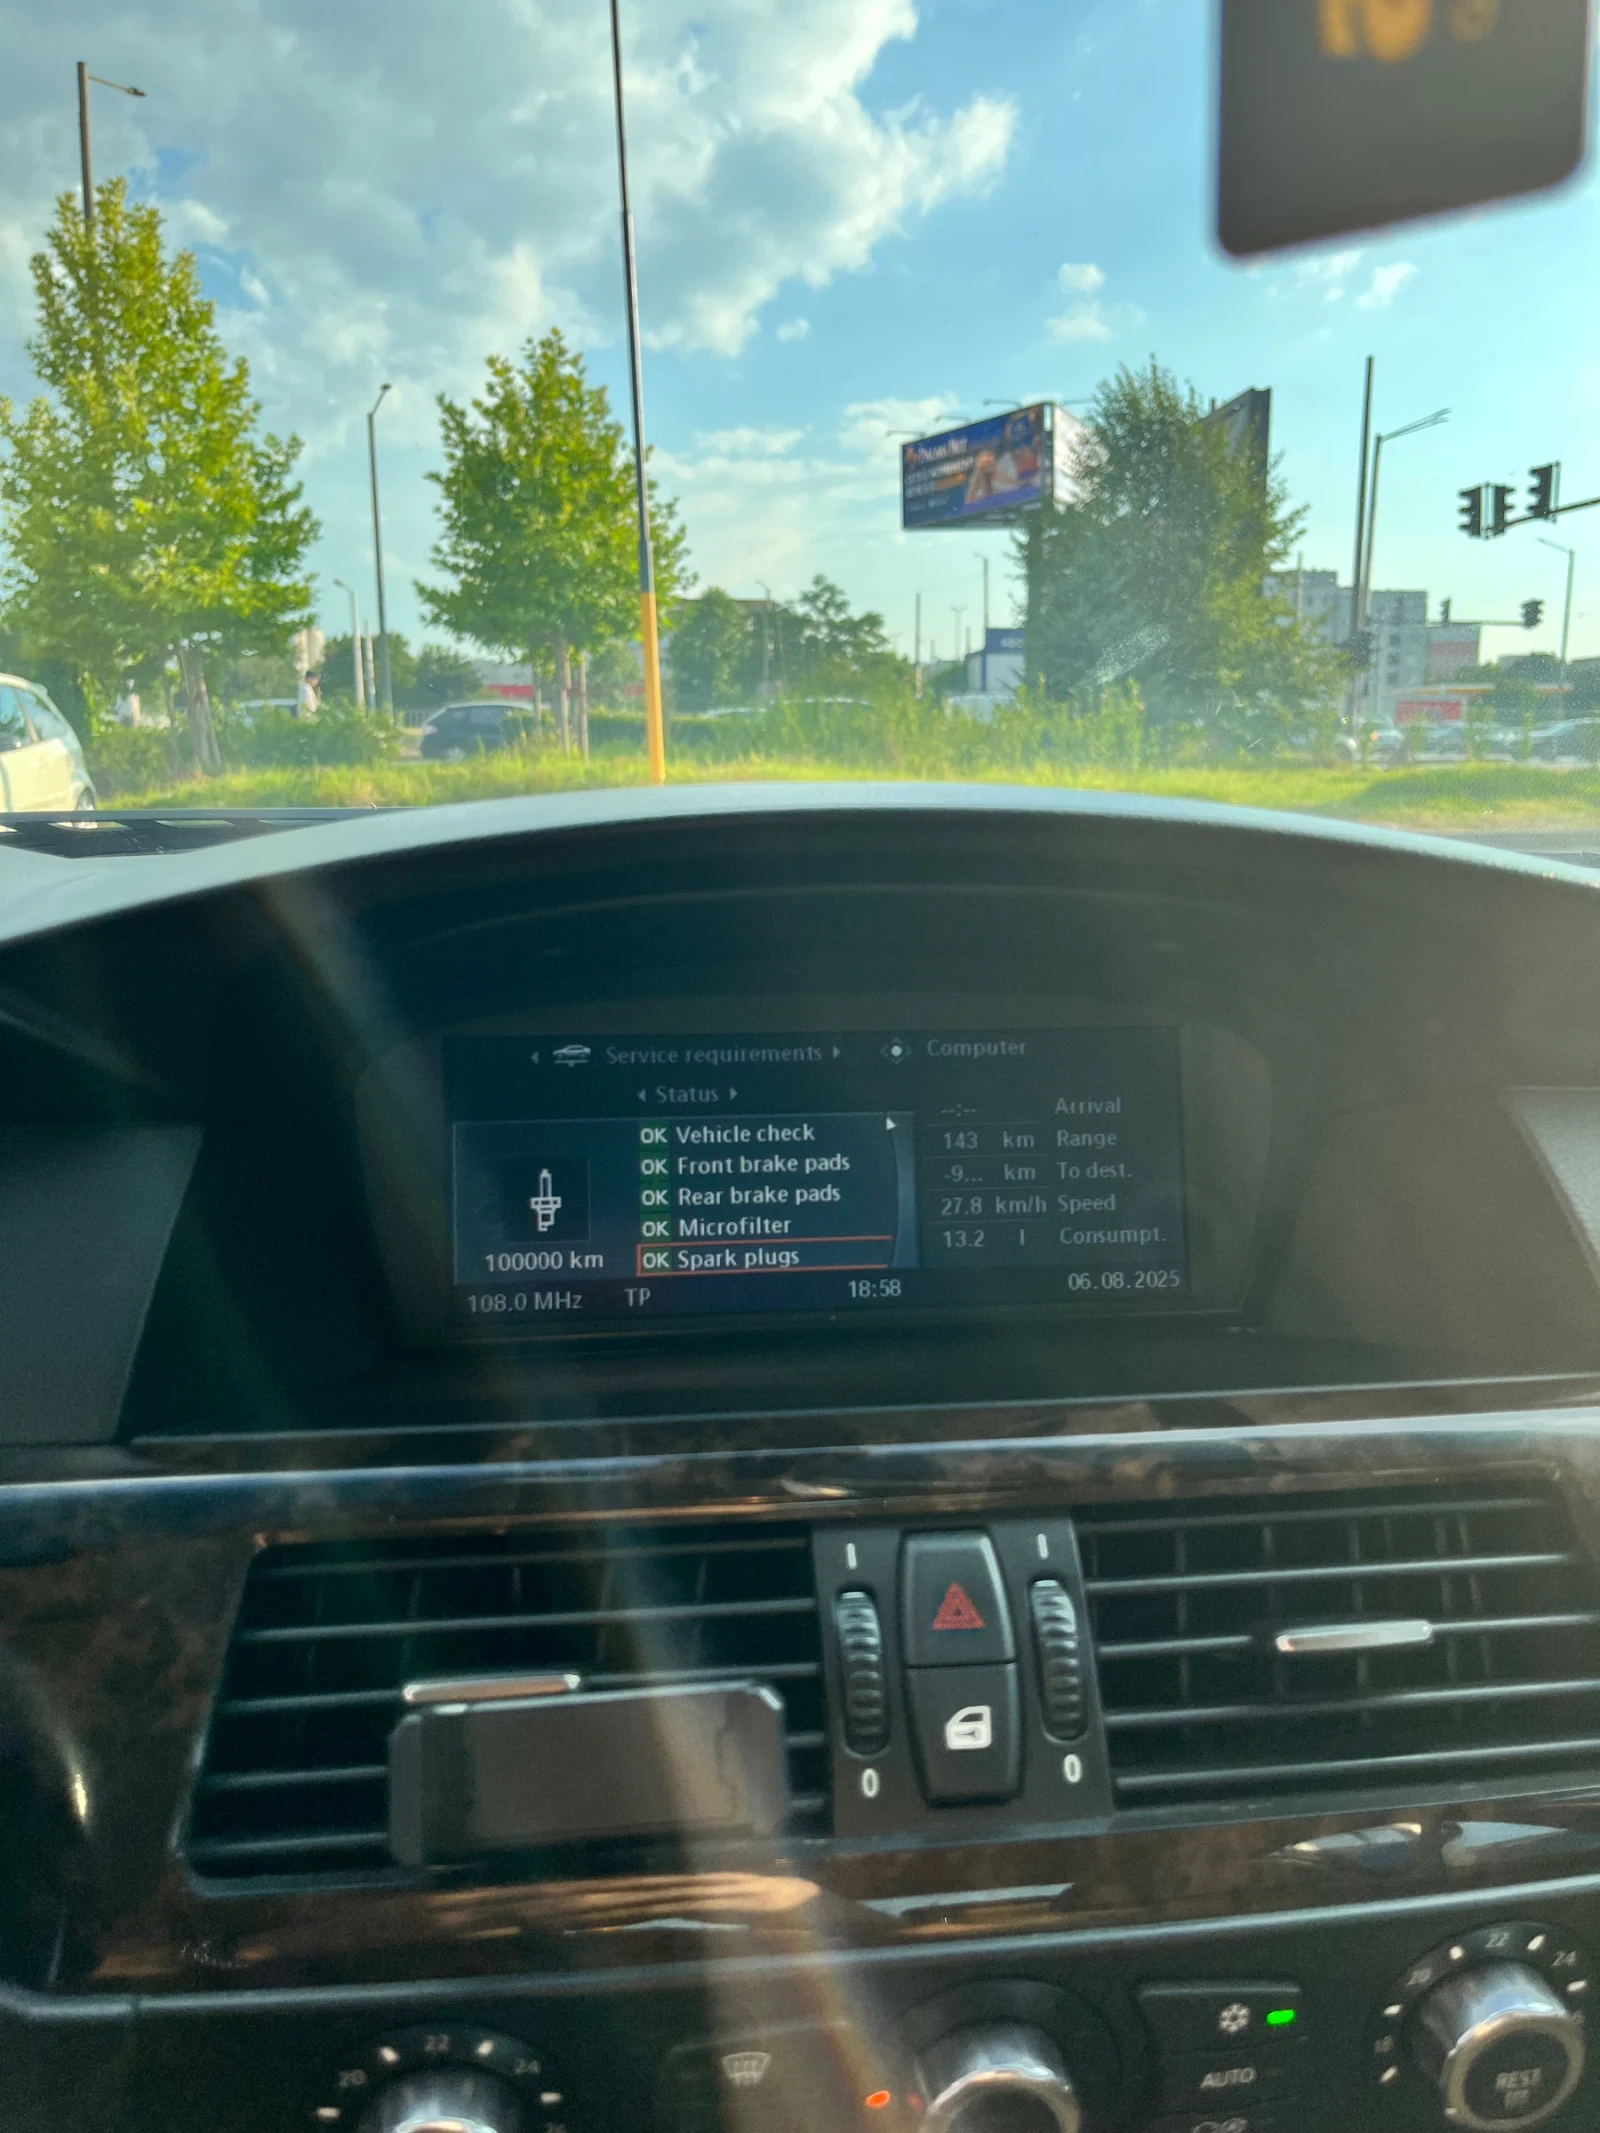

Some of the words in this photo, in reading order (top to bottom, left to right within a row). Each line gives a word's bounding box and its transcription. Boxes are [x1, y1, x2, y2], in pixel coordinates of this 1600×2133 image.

[605, 1046, 679, 1064] Service
[685, 1045, 822, 1070] requirements
[927, 1039, 1026, 1058] Computer
[656, 1085, 719, 1104] Status
[1055, 1097, 1121, 1115] Arrival
[640, 1127, 668, 1144] OK
[676, 1124, 751, 1144] Vehicle
[757, 1122, 815, 1142] check
[942, 1131, 979, 1150] 143
[1003, 1131, 1035, 1149] km
[1057, 1129, 1118, 1150] Range
[641, 1158, 668, 1175] OK
[678, 1157, 733, 1175] Front
[740, 1154, 798, 1173] brake
[805, 1153, 850, 1176] pads
[1004, 1163, 1036, 1181] km
[1057, 1162, 1080, 1179] To
[1086, 1161, 1132, 1179] dest.
[641, 1189, 668, 1206] OK
[678, 1187, 724, 1206] Rear
[731, 1185, 788, 1204] brake
[795, 1184, 841, 1207] pads
[941, 1197, 983, 1216] 27.8
[995, 1195, 1047, 1215] km/h
[1058, 1194, 1116, 1214] Speed
[642, 1220, 668, 1238] OK
[679, 1217, 792, 1237] Microfilter
[1060, 1226, 1167, 1248] Consumpt.
[943, 1230, 985, 1249] 13.2
[485, 1252, 563, 1272] 100000
[569, 1250, 604, 1270] km
[642, 1251, 669, 1269] OK
[678, 1247, 738, 1272] Spark
[744, 1246, 800, 1271] plugs
[848, 1279, 901, 1299] 18:58
[1068, 1270, 1180, 1290] 06.08.2025
[467, 1293, 527, 1313] 108.0
[534, 1291, 582, 1311] MHz
[624, 1288, 651, 1307] TP
[1485, 1931, 1511, 1948] 22
[1551, 1950, 1577, 1967] 24
[425, 2034, 449, 2052] 22
[514, 2058, 541, 2075] 24
[339, 2069, 367, 2088] 20
[1200, 2067, 1257, 2089] AUTO
